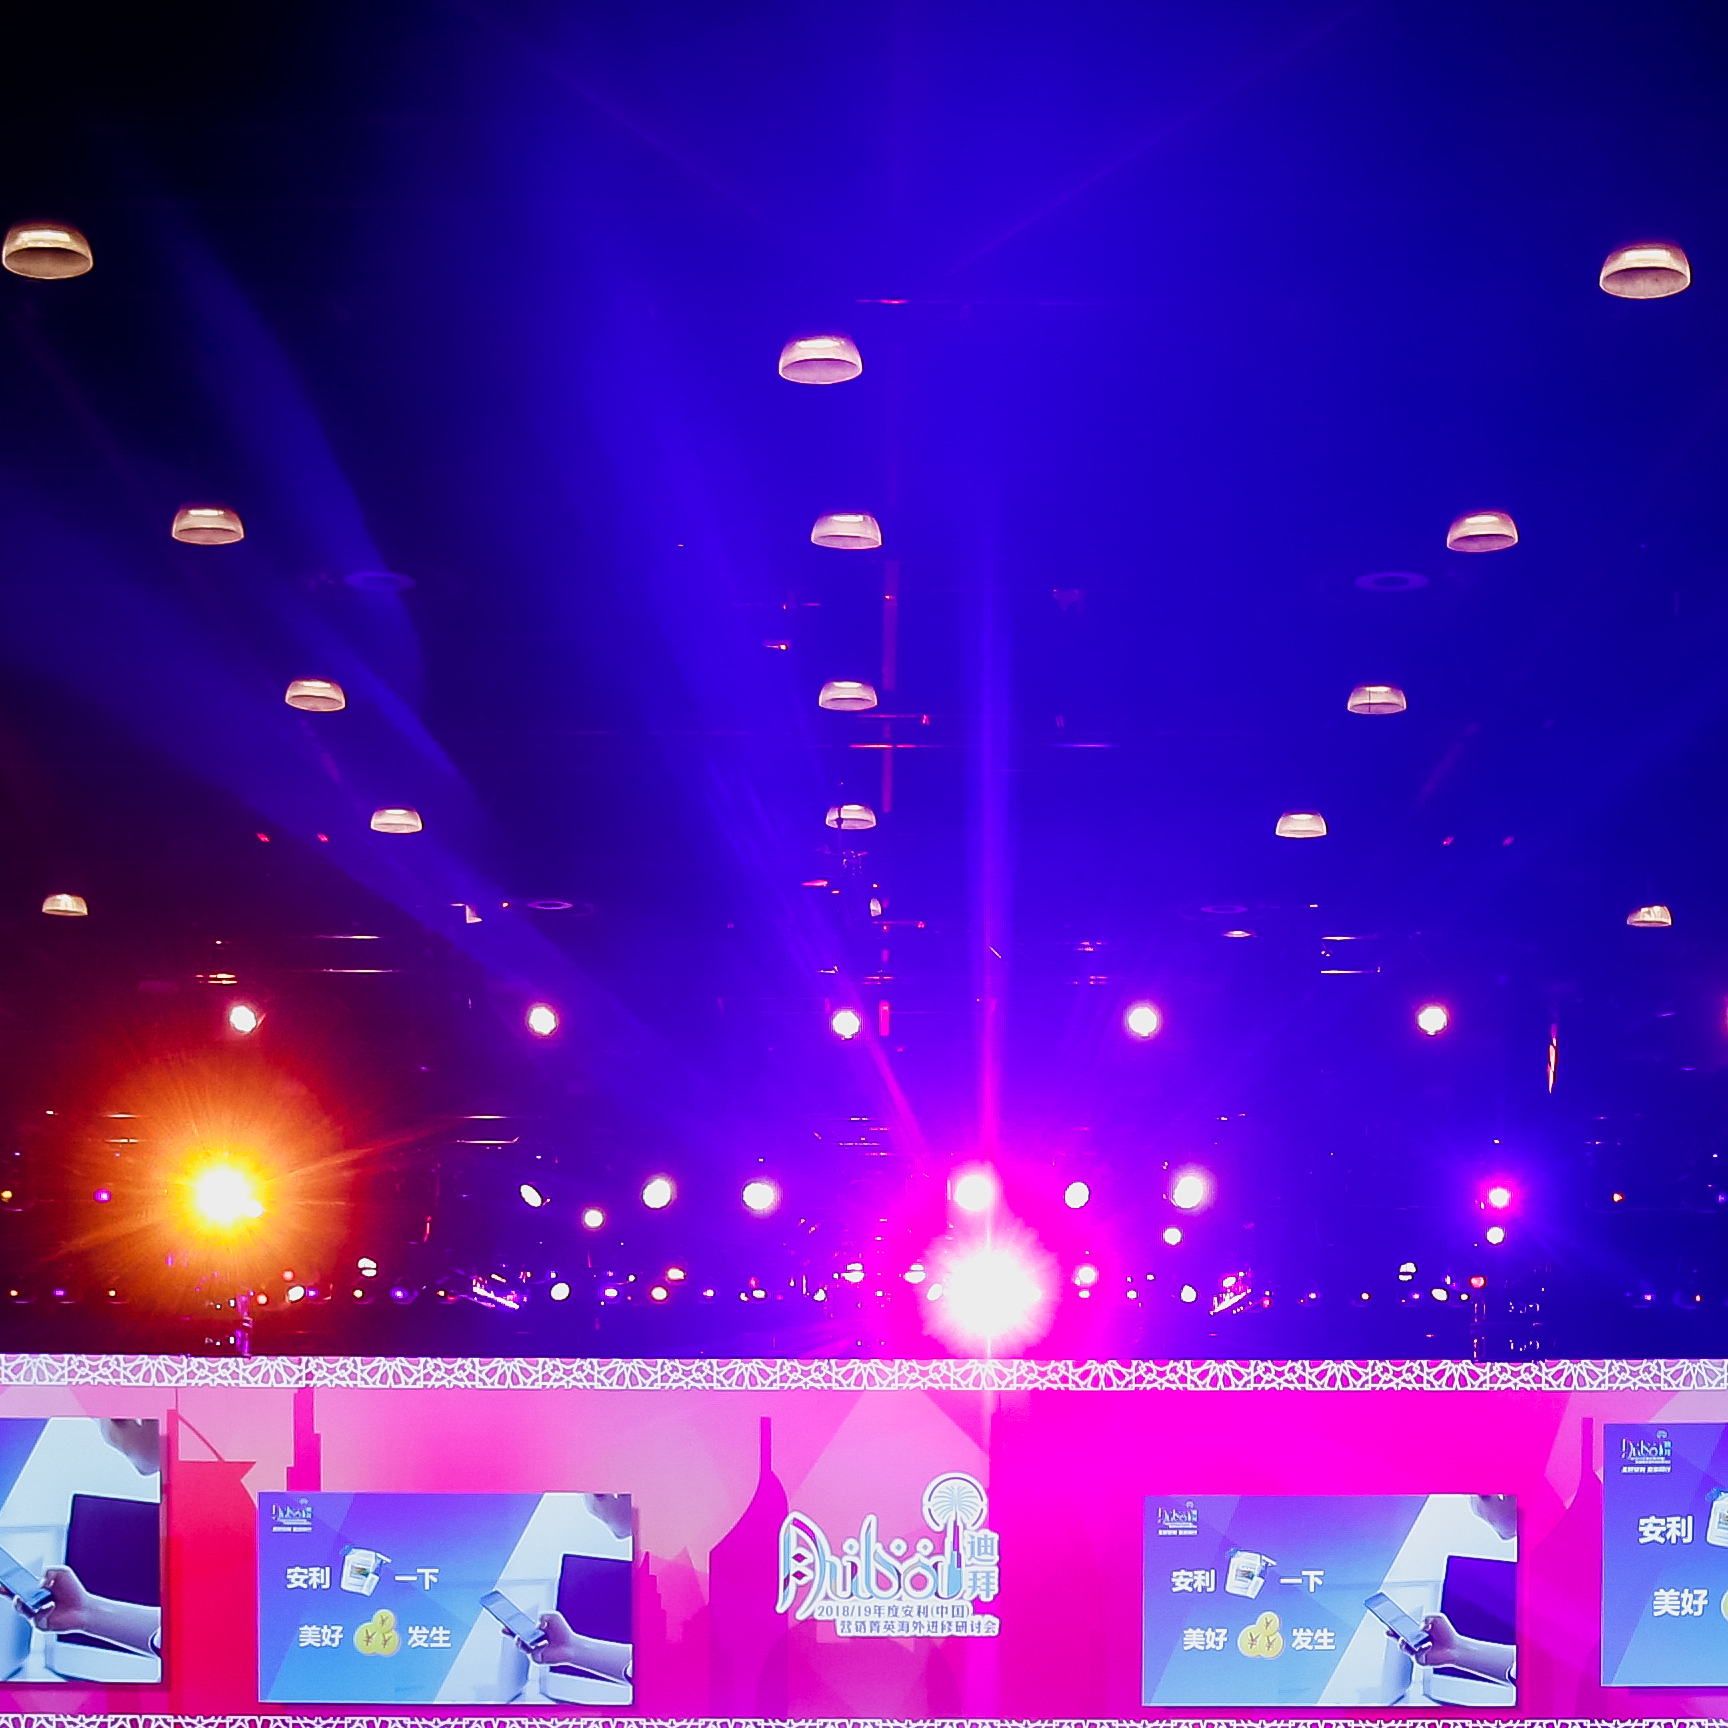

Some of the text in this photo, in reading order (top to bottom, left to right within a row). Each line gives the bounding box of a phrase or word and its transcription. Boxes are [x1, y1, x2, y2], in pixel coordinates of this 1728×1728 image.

[1638, 1515, 1693, 1544] 安利
[286, 1566, 439, 1590] 安利 一下
[966, 1533, 996, 1600] 迪拜
[1170, 1569, 1324, 1593] 安利 一下
[1652, 1588, 1709, 1617] 美好
[298, 1624, 452, 1648] 美好 发生
[1183, 1627, 1336, 1651] 美好 发生
